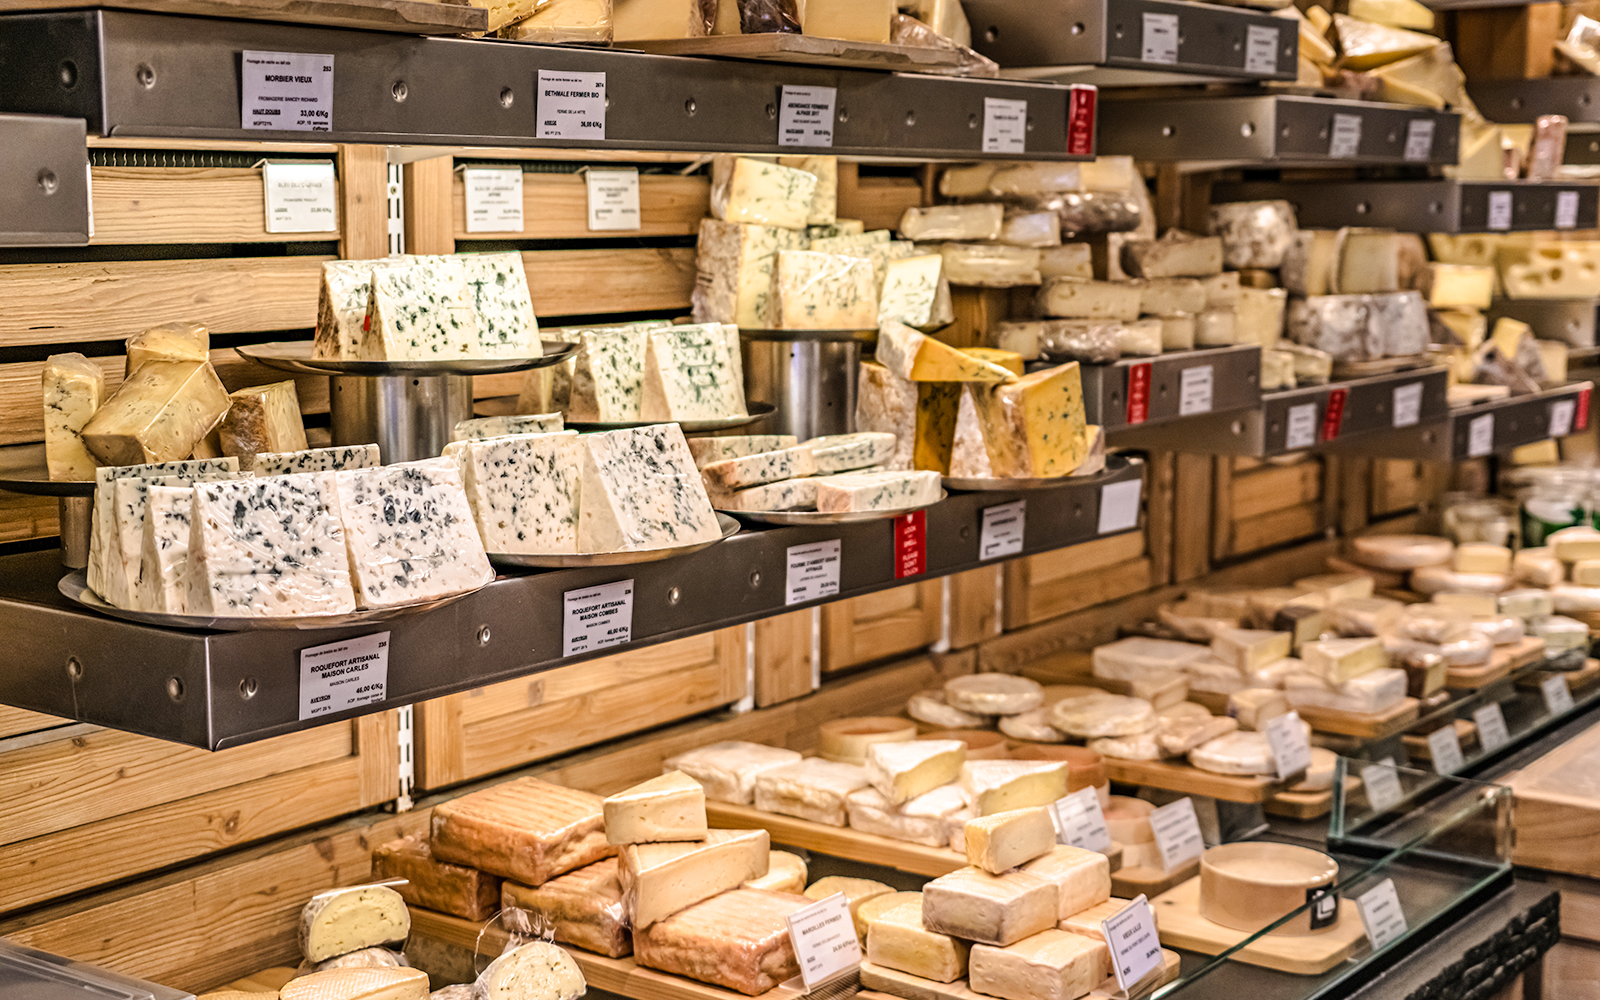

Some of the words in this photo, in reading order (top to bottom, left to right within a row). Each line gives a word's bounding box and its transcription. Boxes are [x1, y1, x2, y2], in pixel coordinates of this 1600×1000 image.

[300, 110, 315, 118] 33,00
[316, 110, 328, 118] €/Kg
[904, 525, 916, 534] LOOK
[903, 538, 917, 548] SMELL
[902, 550, 918, 562] PLEASE
[903, 566, 918, 577] TOUCH
[572, 604, 601, 615] ROQUEFORT
[601, 599, 626, 609] ARTISANAL
[580, 612, 598, 621] MAISON
[599, 608, 618, 616] COMBES
[310, 660, 347, 673] ROQUEFORT
[348, 653, 380, 664] ARTISANAL
[322, 669, 345, 679] MAISON
[346, 663, 368, 673] CARLES
[310, 695, 331, 704] AVEYRON
